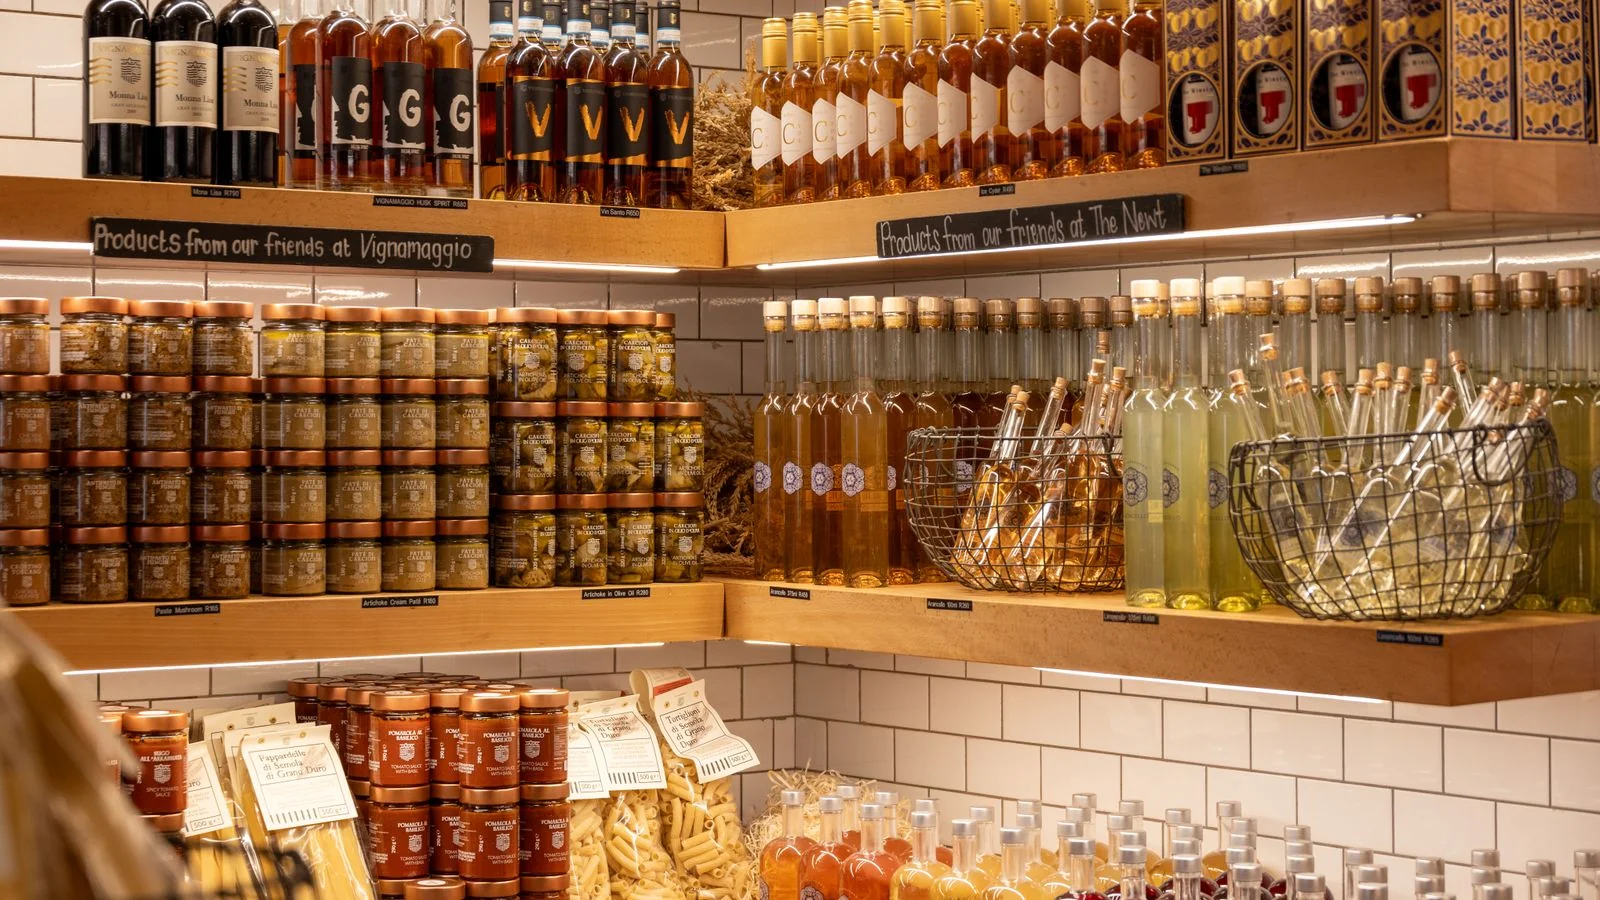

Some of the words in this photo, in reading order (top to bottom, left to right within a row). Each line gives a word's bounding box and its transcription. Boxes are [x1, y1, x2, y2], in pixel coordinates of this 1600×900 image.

[109, 90, 136, 100] Monna
[176, 94, 201, 103] Monna
[244, 98, 269, 108] Monna
[348, 84, 370, 123] G
[398, 88, 422, 127] G
[449, 94, 471, 132] G
[525, 101, 552, 138] V
[579, 104, 602, 140] V
[619, 106, 645, 142] V
[664, 109, 690, 145] V
[782, 122, 795, 145] C
[814, 120, 828, 142] C
[375, 198, 415, 206] VIGNAMAGGIO
[433, 199, 450, 207] SPIRIT
[610, 208, 625, 216] Santo
[880, 221, 940, 257] Products
[942, 216, 976, 251] from
[982, 226, 1002, 246] our
[1006, 208, 1064, 245] friends
[1070, 212, 1086, 237] at
[1089, 204, 1118, 235] The
[1122, 199, 1168, 234] Newt
[95, 223, 181, 253] Products
[186, 227, 228, 256] from
[233, 238, 258, 256] our
[265, 232, 325, 258] friends
[334, 238, 352, 258] at
[361, 232, 472, 268] Vignamaggio
[665, 706, 701, 725] Tortiglioni
[679, 716, 703, 730] Semola
[676, 733, 684, 741] di
[684, 724, 705, 738] Grano
[680, 738, 698, 749] Duro
[258, 750, 306, 762] Pappardelle
[263, 764, 272, 772] di
[274, 759, 303, 769] Semola
[276, 769, 303, 778] Grano
[305, 766, 326, 774] Duro
